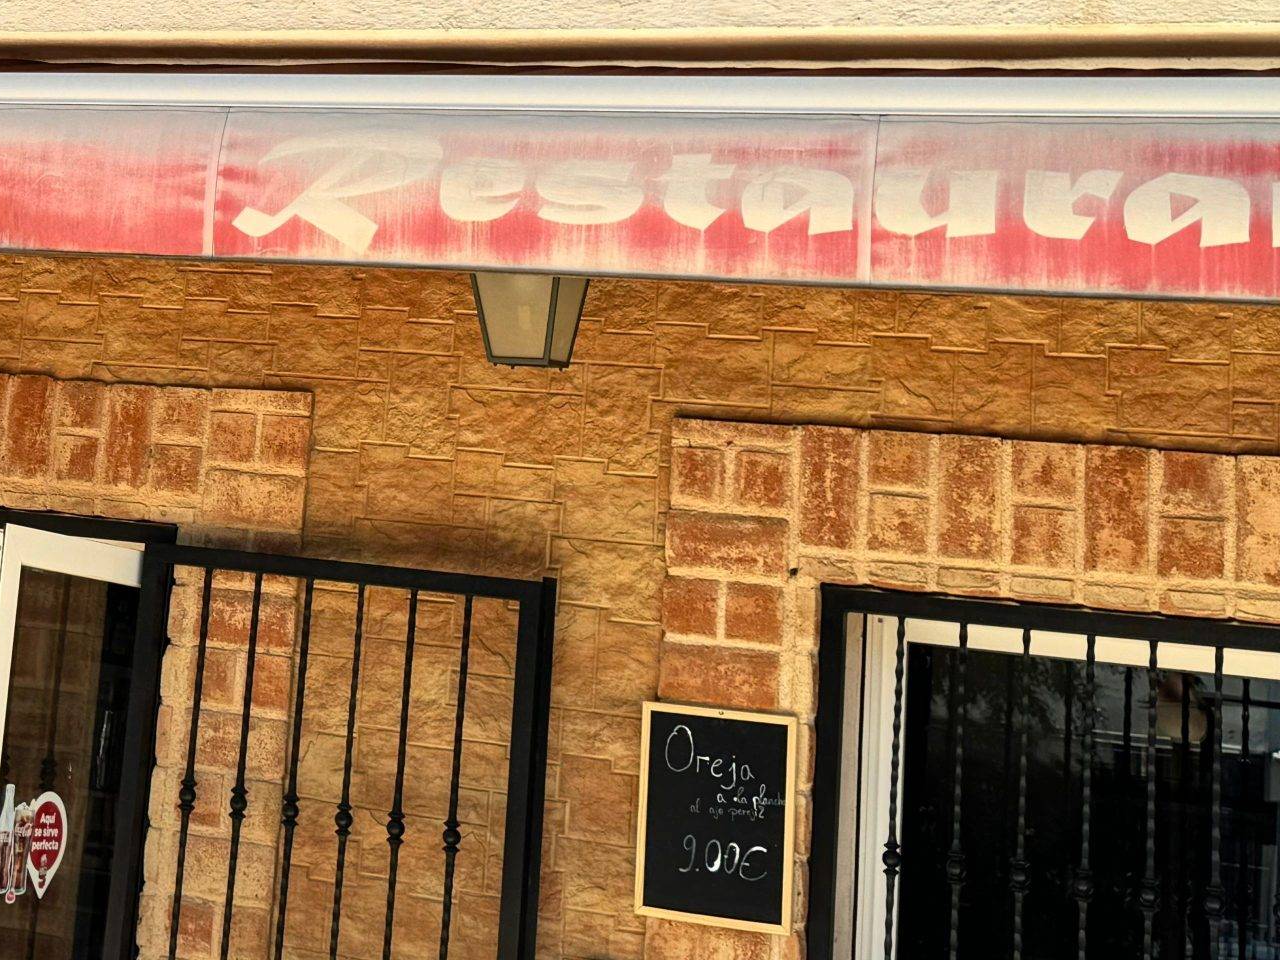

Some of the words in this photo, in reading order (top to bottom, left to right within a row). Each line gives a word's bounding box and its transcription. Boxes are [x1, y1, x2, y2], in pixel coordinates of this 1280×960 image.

[231, 131, 1280, 253] Restaura
[665, 724, 755, 790] Oreja
[31, 837, 59, 852] perfecta
[34, 826, 43, 837] se
[43, 825, 59, 837] sirve
